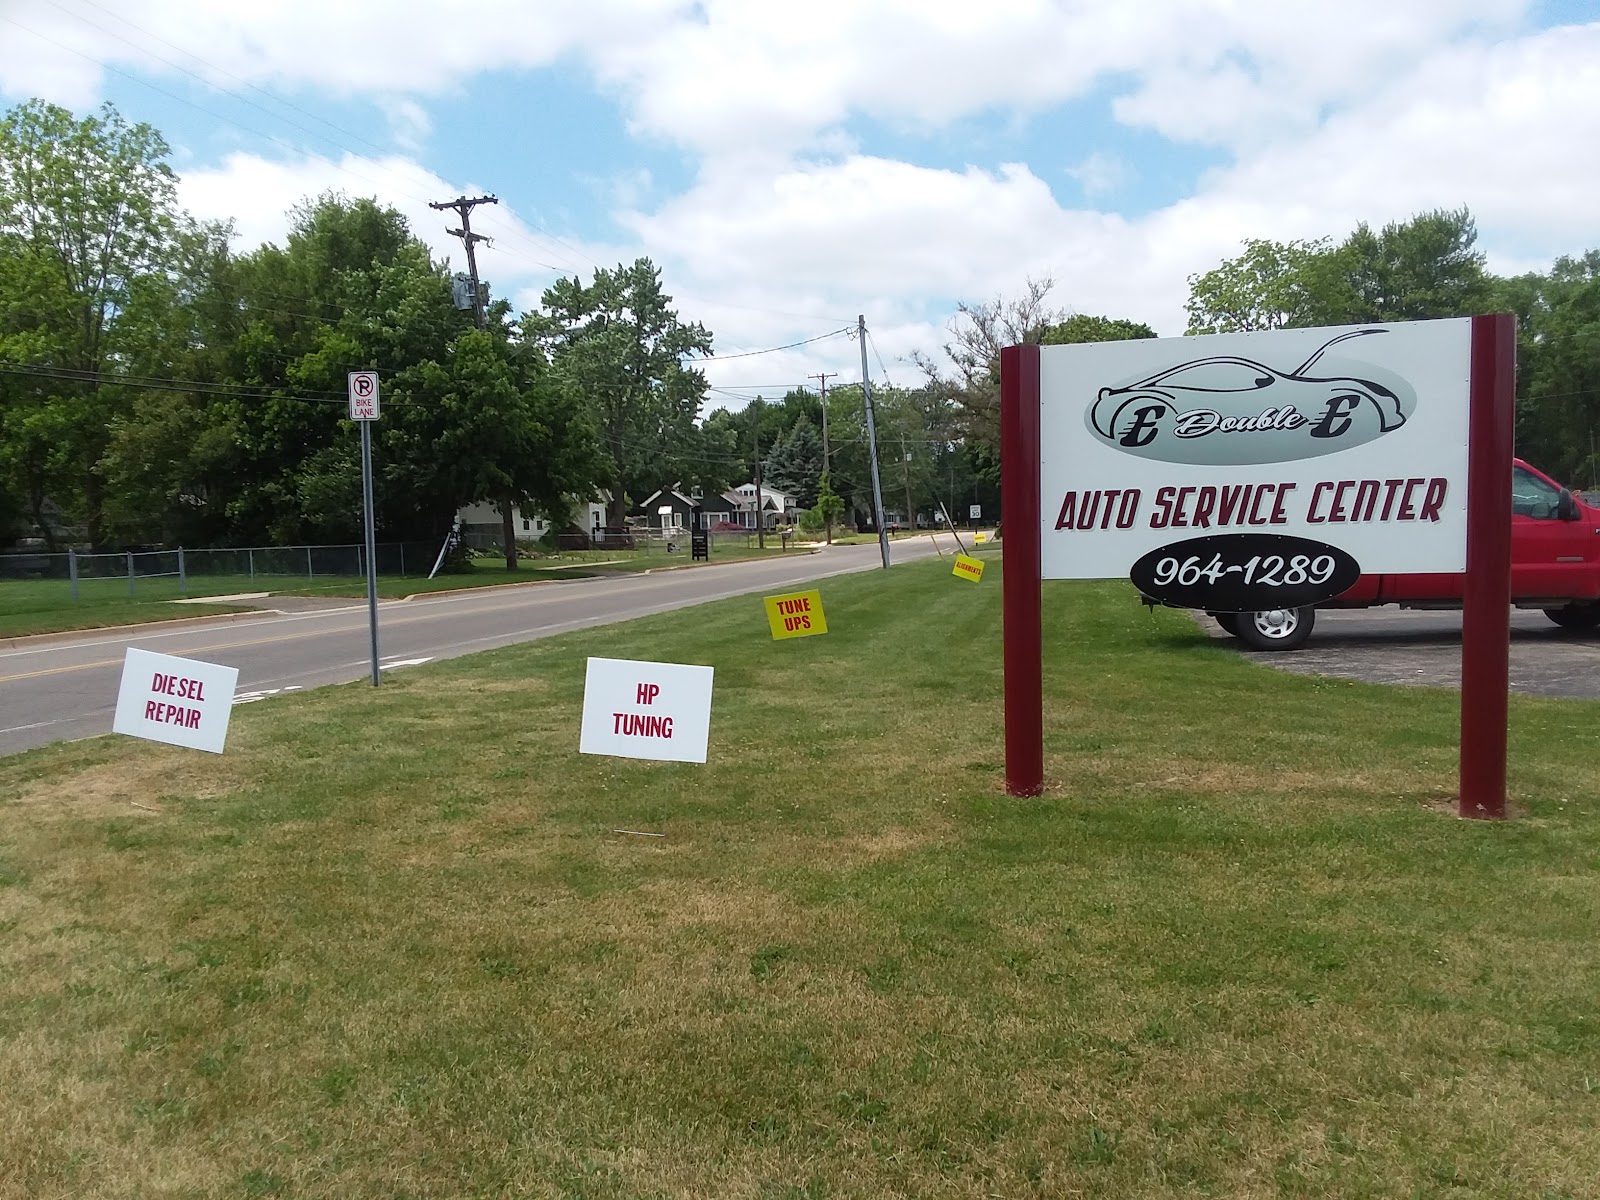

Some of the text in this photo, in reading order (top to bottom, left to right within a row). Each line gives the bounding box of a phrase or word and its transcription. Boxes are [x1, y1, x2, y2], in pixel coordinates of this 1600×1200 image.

[354, 408, 374, 416] LANE
[1173, 404, 1309, 439] Double
[1054, 477, 1448, 531] AUTO SERVICE CENTER
[1153, 552, 1336, 587] 964-1289
[776, 597, 811, 616] TUNE
[784, 615, 811, 632] UPS
[151, 672, 205, 702] DIESEL
[636, 683, 660, 705] HP
[144, 700, 202, 730] REPAIR
[612, 712, 674, 739] TUNING
